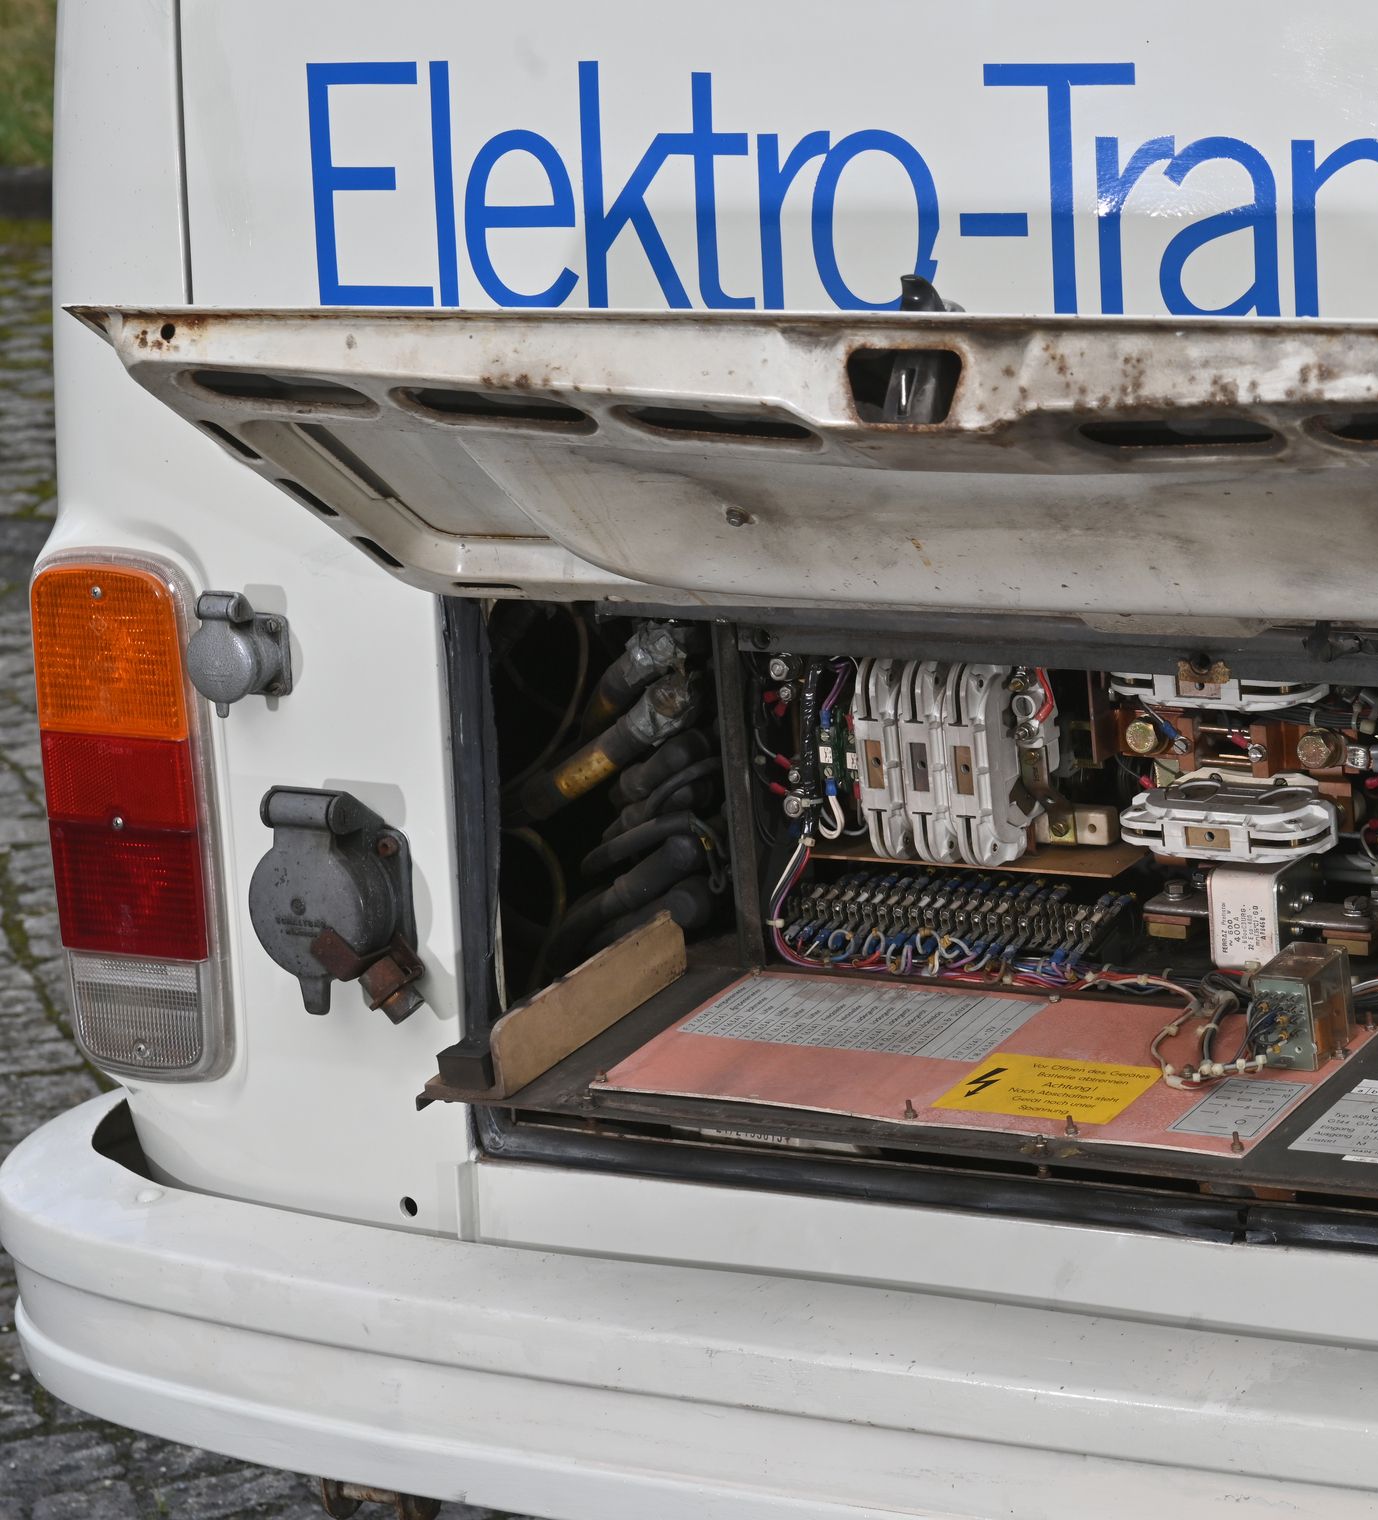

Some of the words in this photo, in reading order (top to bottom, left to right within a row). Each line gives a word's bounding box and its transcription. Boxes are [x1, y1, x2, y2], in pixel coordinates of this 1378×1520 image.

[1037, 1072, 1076, 1080] Batterie
[1078, 1075, 1129, 1085] abtrennen
[1037, 1090, 1093, 1100] Abschalten
[1018, 1104, 1069, 1115] Spannung
[1314, 1131, 1352, 1139] Ausgang
